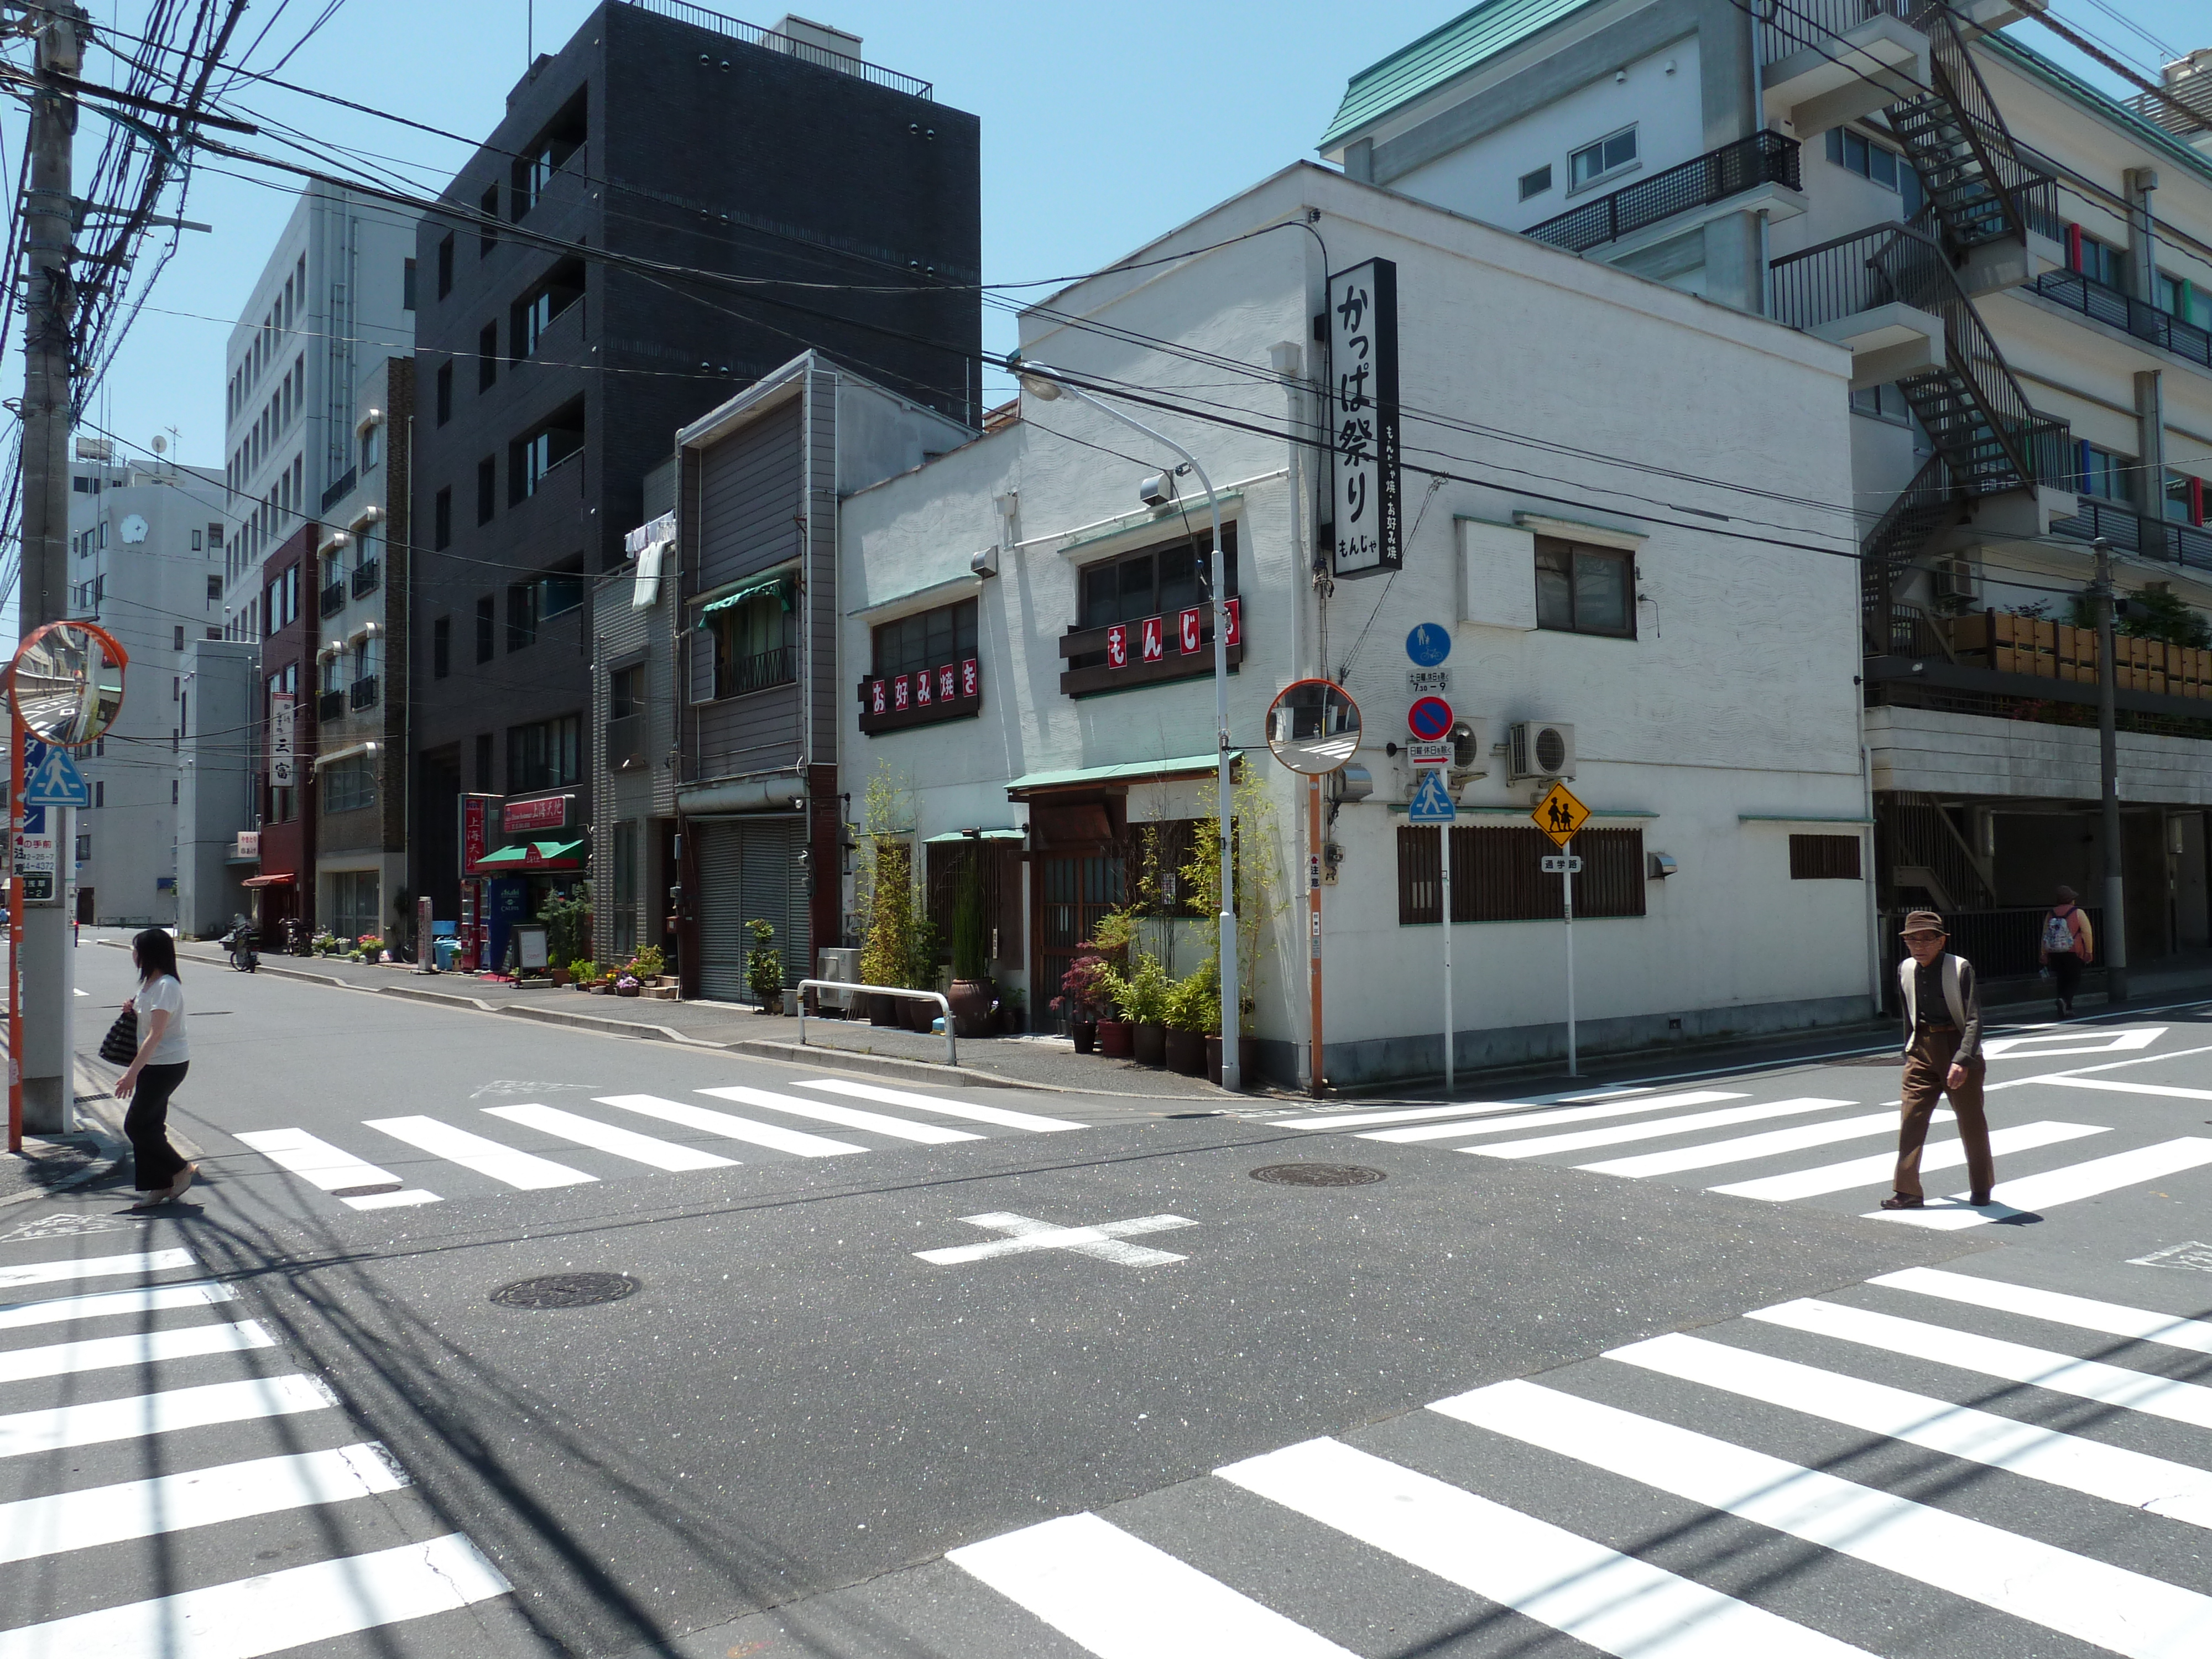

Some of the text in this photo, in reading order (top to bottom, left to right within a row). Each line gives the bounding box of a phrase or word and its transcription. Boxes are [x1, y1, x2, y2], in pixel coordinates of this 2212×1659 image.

[1337, 284, 1372, 524] かっぱ祭り
[1338, 534, 1377, 558] もんじゃ
[873, 660, 977, 713] お好み焼き
[275, 738, 290, 780] 三富
[24, 738, 38, 827] タカシ
[24, 840, 51, 849] の手前
[1311, 866, 1319, 888] 注意
[1545, 859, 1577, 869] 通学路
